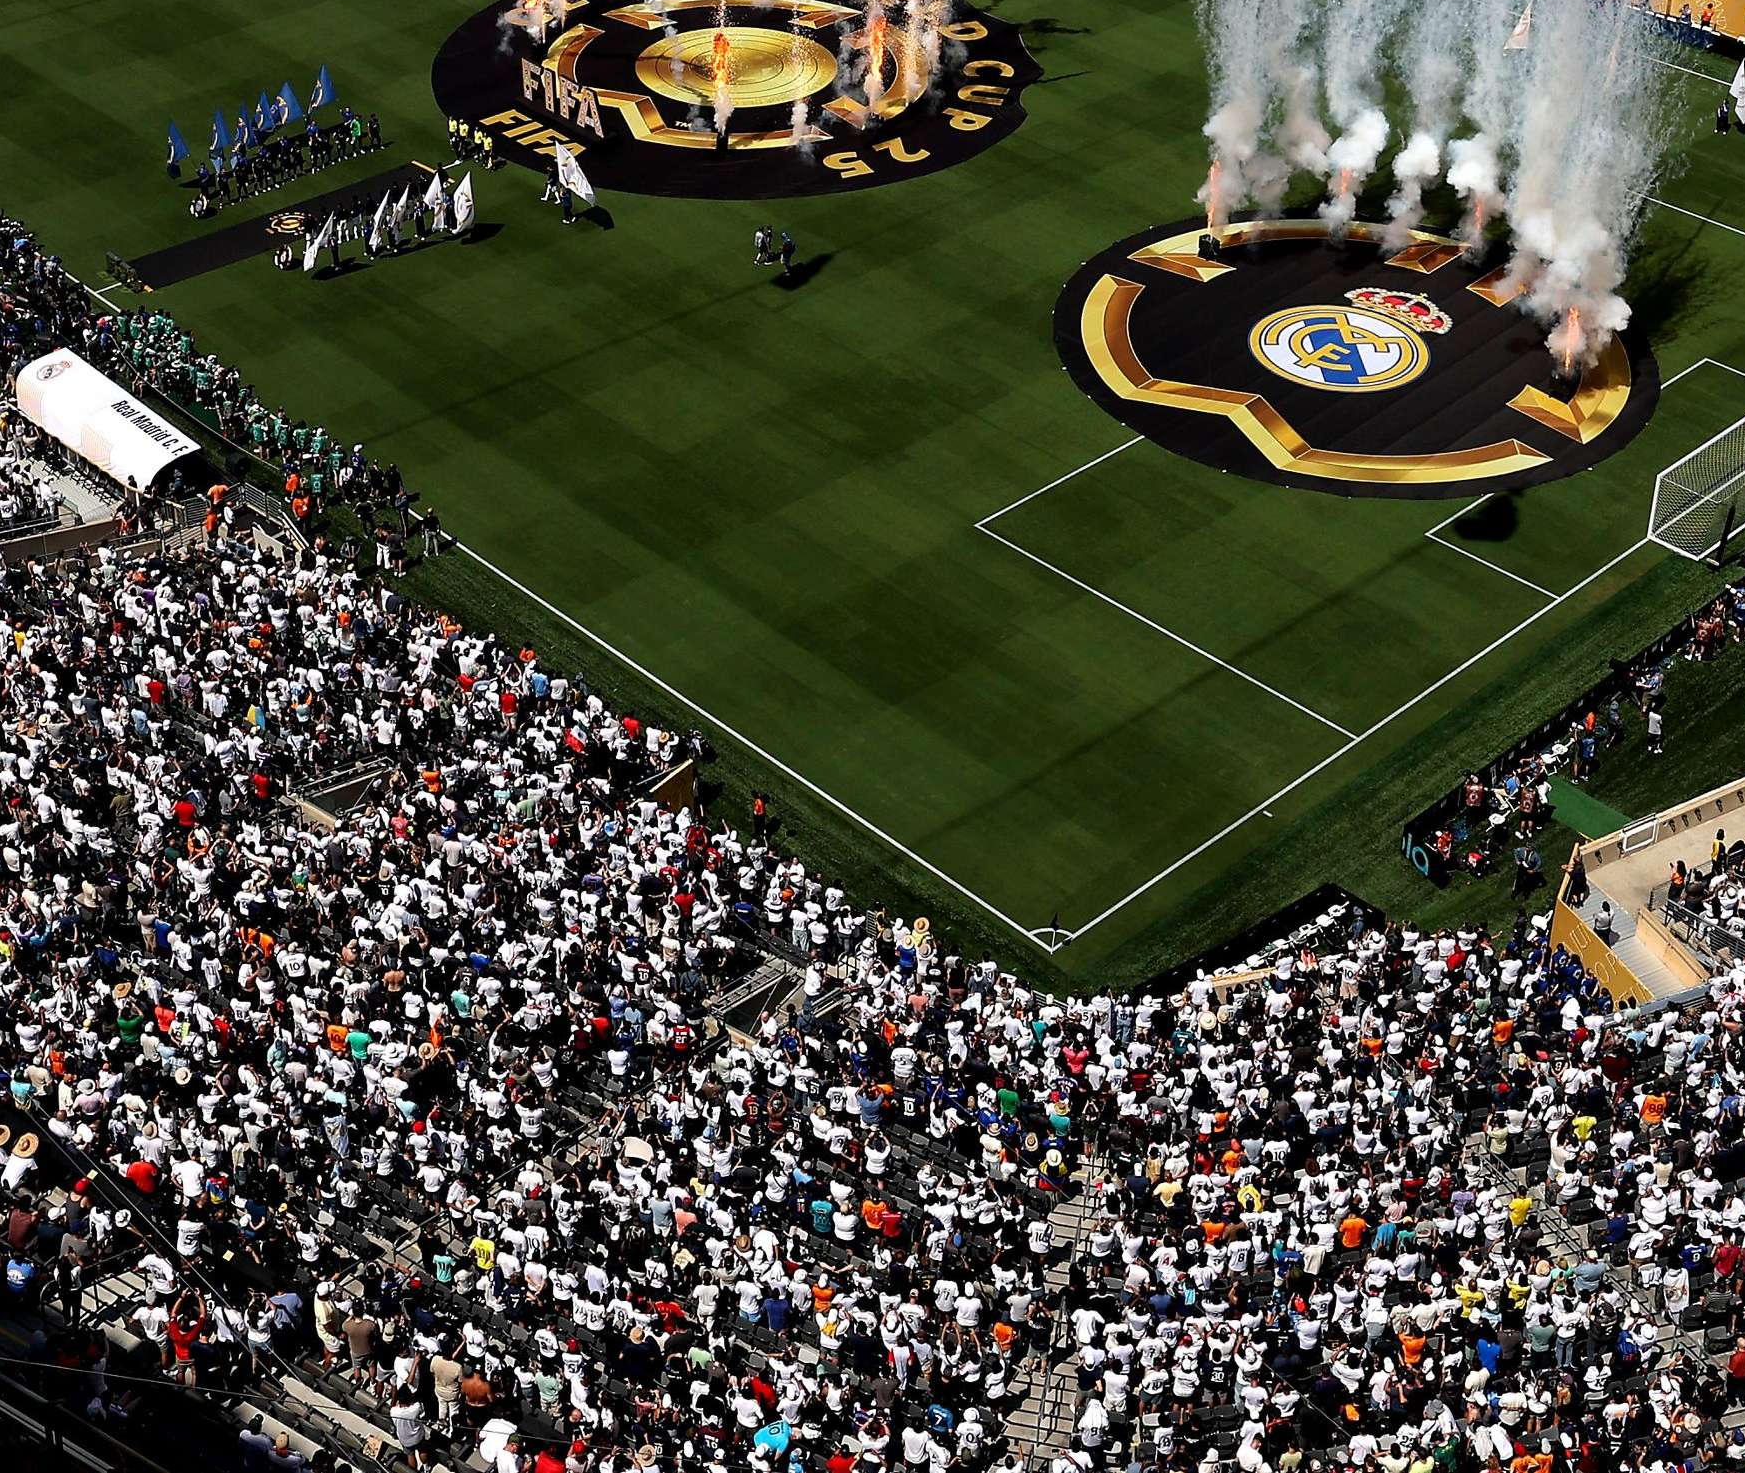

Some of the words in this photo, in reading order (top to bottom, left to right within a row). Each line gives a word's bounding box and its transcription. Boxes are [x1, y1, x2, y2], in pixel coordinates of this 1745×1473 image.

[520, 55, 607, 139] FIFA
[940, 58, 1013, 134] CUP
[110, 399, 133, 419] Real
[131, 412, 169, 442] Madrid
[162, 438, 175, 449] C.
[171, 445, 189, 456] F.
